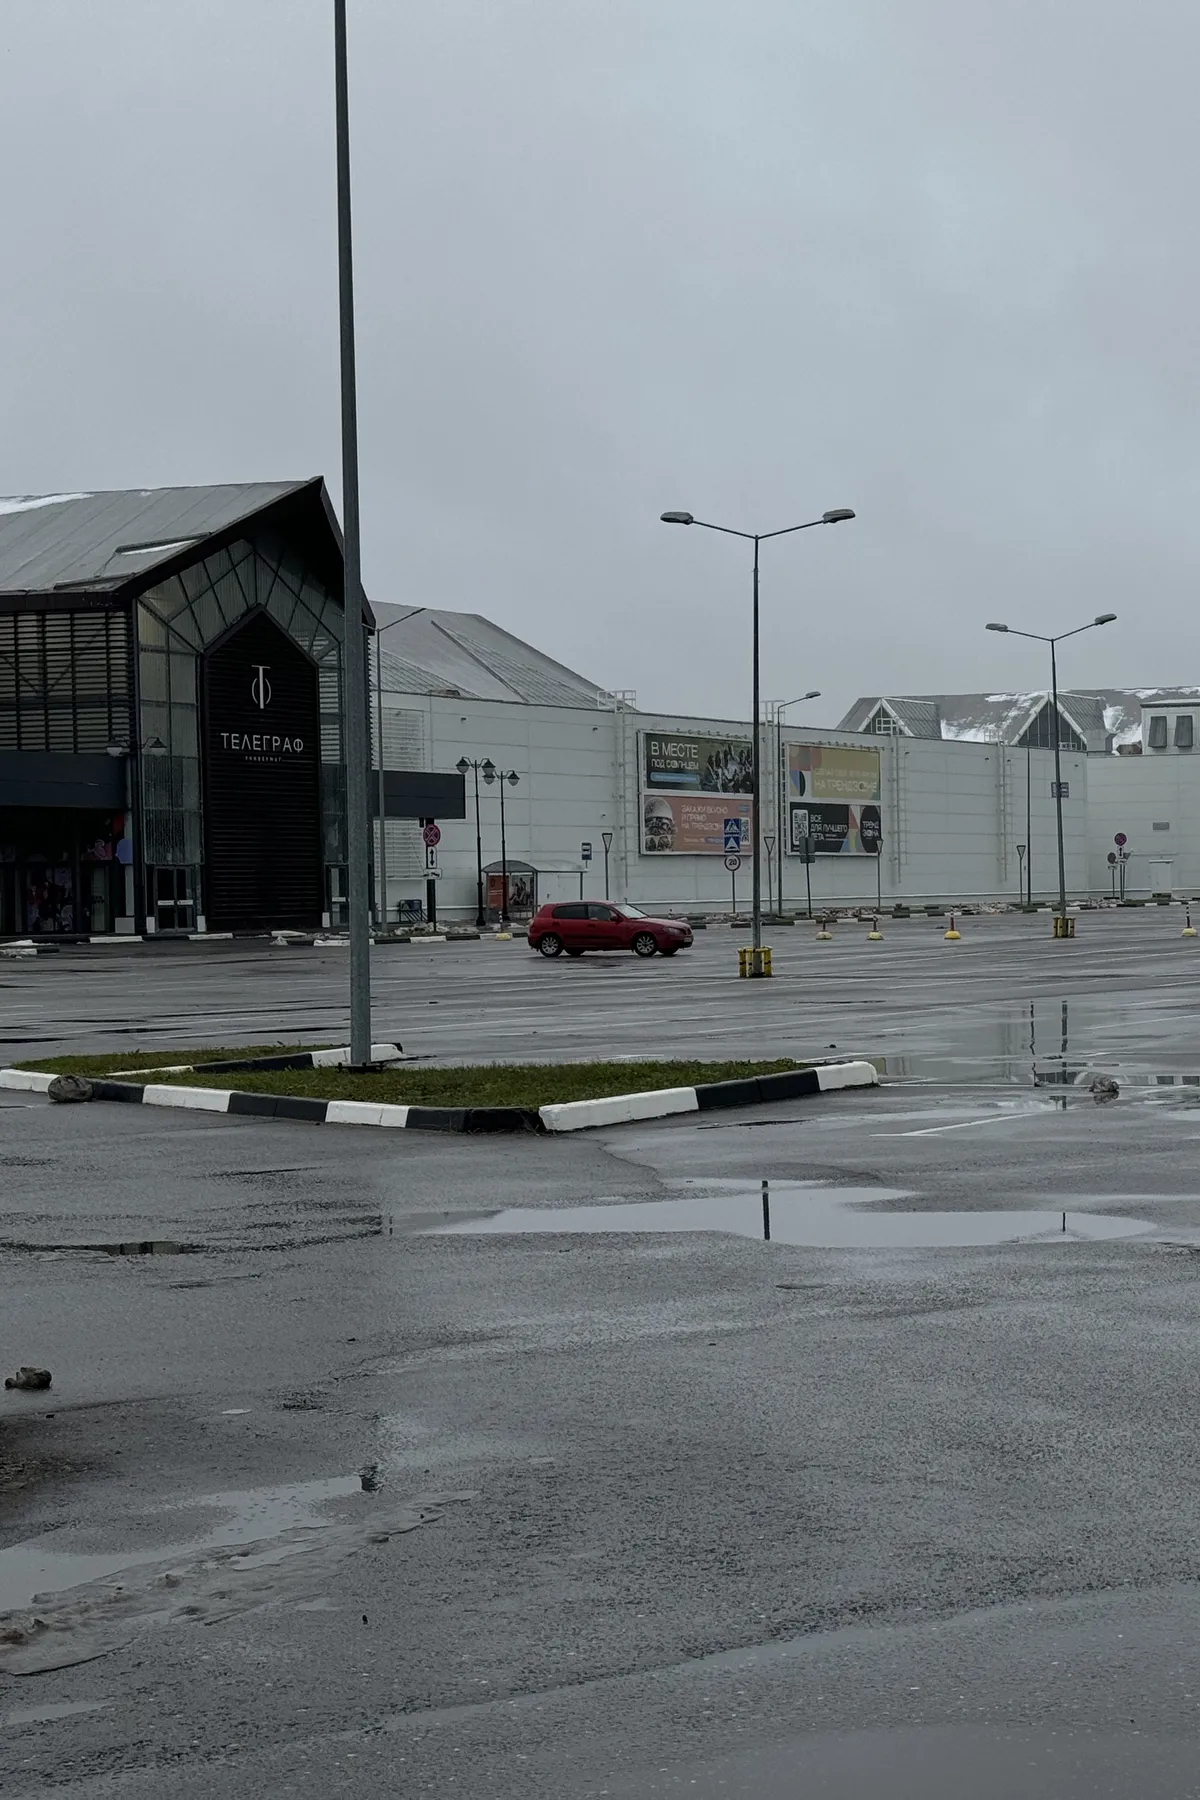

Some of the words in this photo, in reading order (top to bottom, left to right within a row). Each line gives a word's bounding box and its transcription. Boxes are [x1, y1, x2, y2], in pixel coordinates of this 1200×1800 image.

[220, 732, 304, 753] ТЕЛЕГРАФ
[651, 741, 660, 756] В
[662, 742, 699, 759] МЕСТЕ
[651, 758, 666, 769] ПОД
[728, 858, 737, 866] 20
